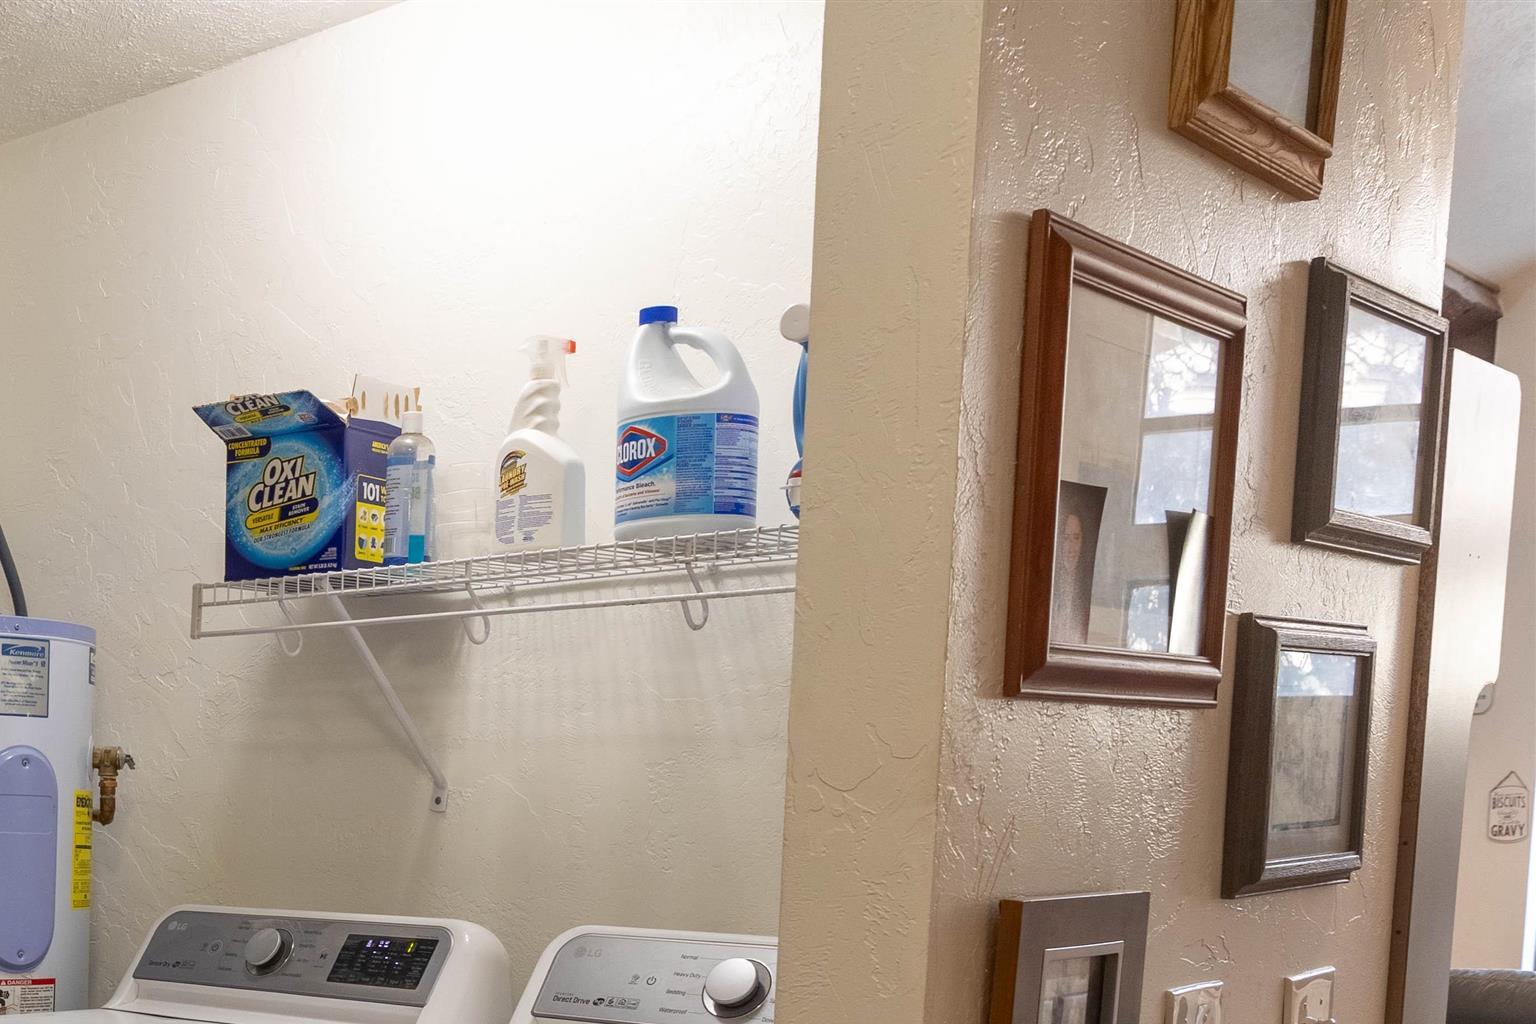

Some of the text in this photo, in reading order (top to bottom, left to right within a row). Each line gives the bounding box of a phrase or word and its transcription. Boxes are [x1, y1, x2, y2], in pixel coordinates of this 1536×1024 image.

[225, 393, 280, 416] CLEAN
[234, 446, 260, 457] FORMULA
[263, 456, 304, 487] OXI
[248, 472, 316, 512] CLEAN
[363, 482, 380, 502] 101
[9, 649, 44, 658] Kenmore
[1491, 795, 1525, 809] BISCUITS
[1490, 824, 1525, 836] GRAVY
[177, 922, 188, 931] LG
[587, 949, 602, 958] LG
[665, 988, 686, 996] Bedding
[552, 995, 590, 1005] Direct Drive
[658, 1007, 688, 1015] Waterproof
